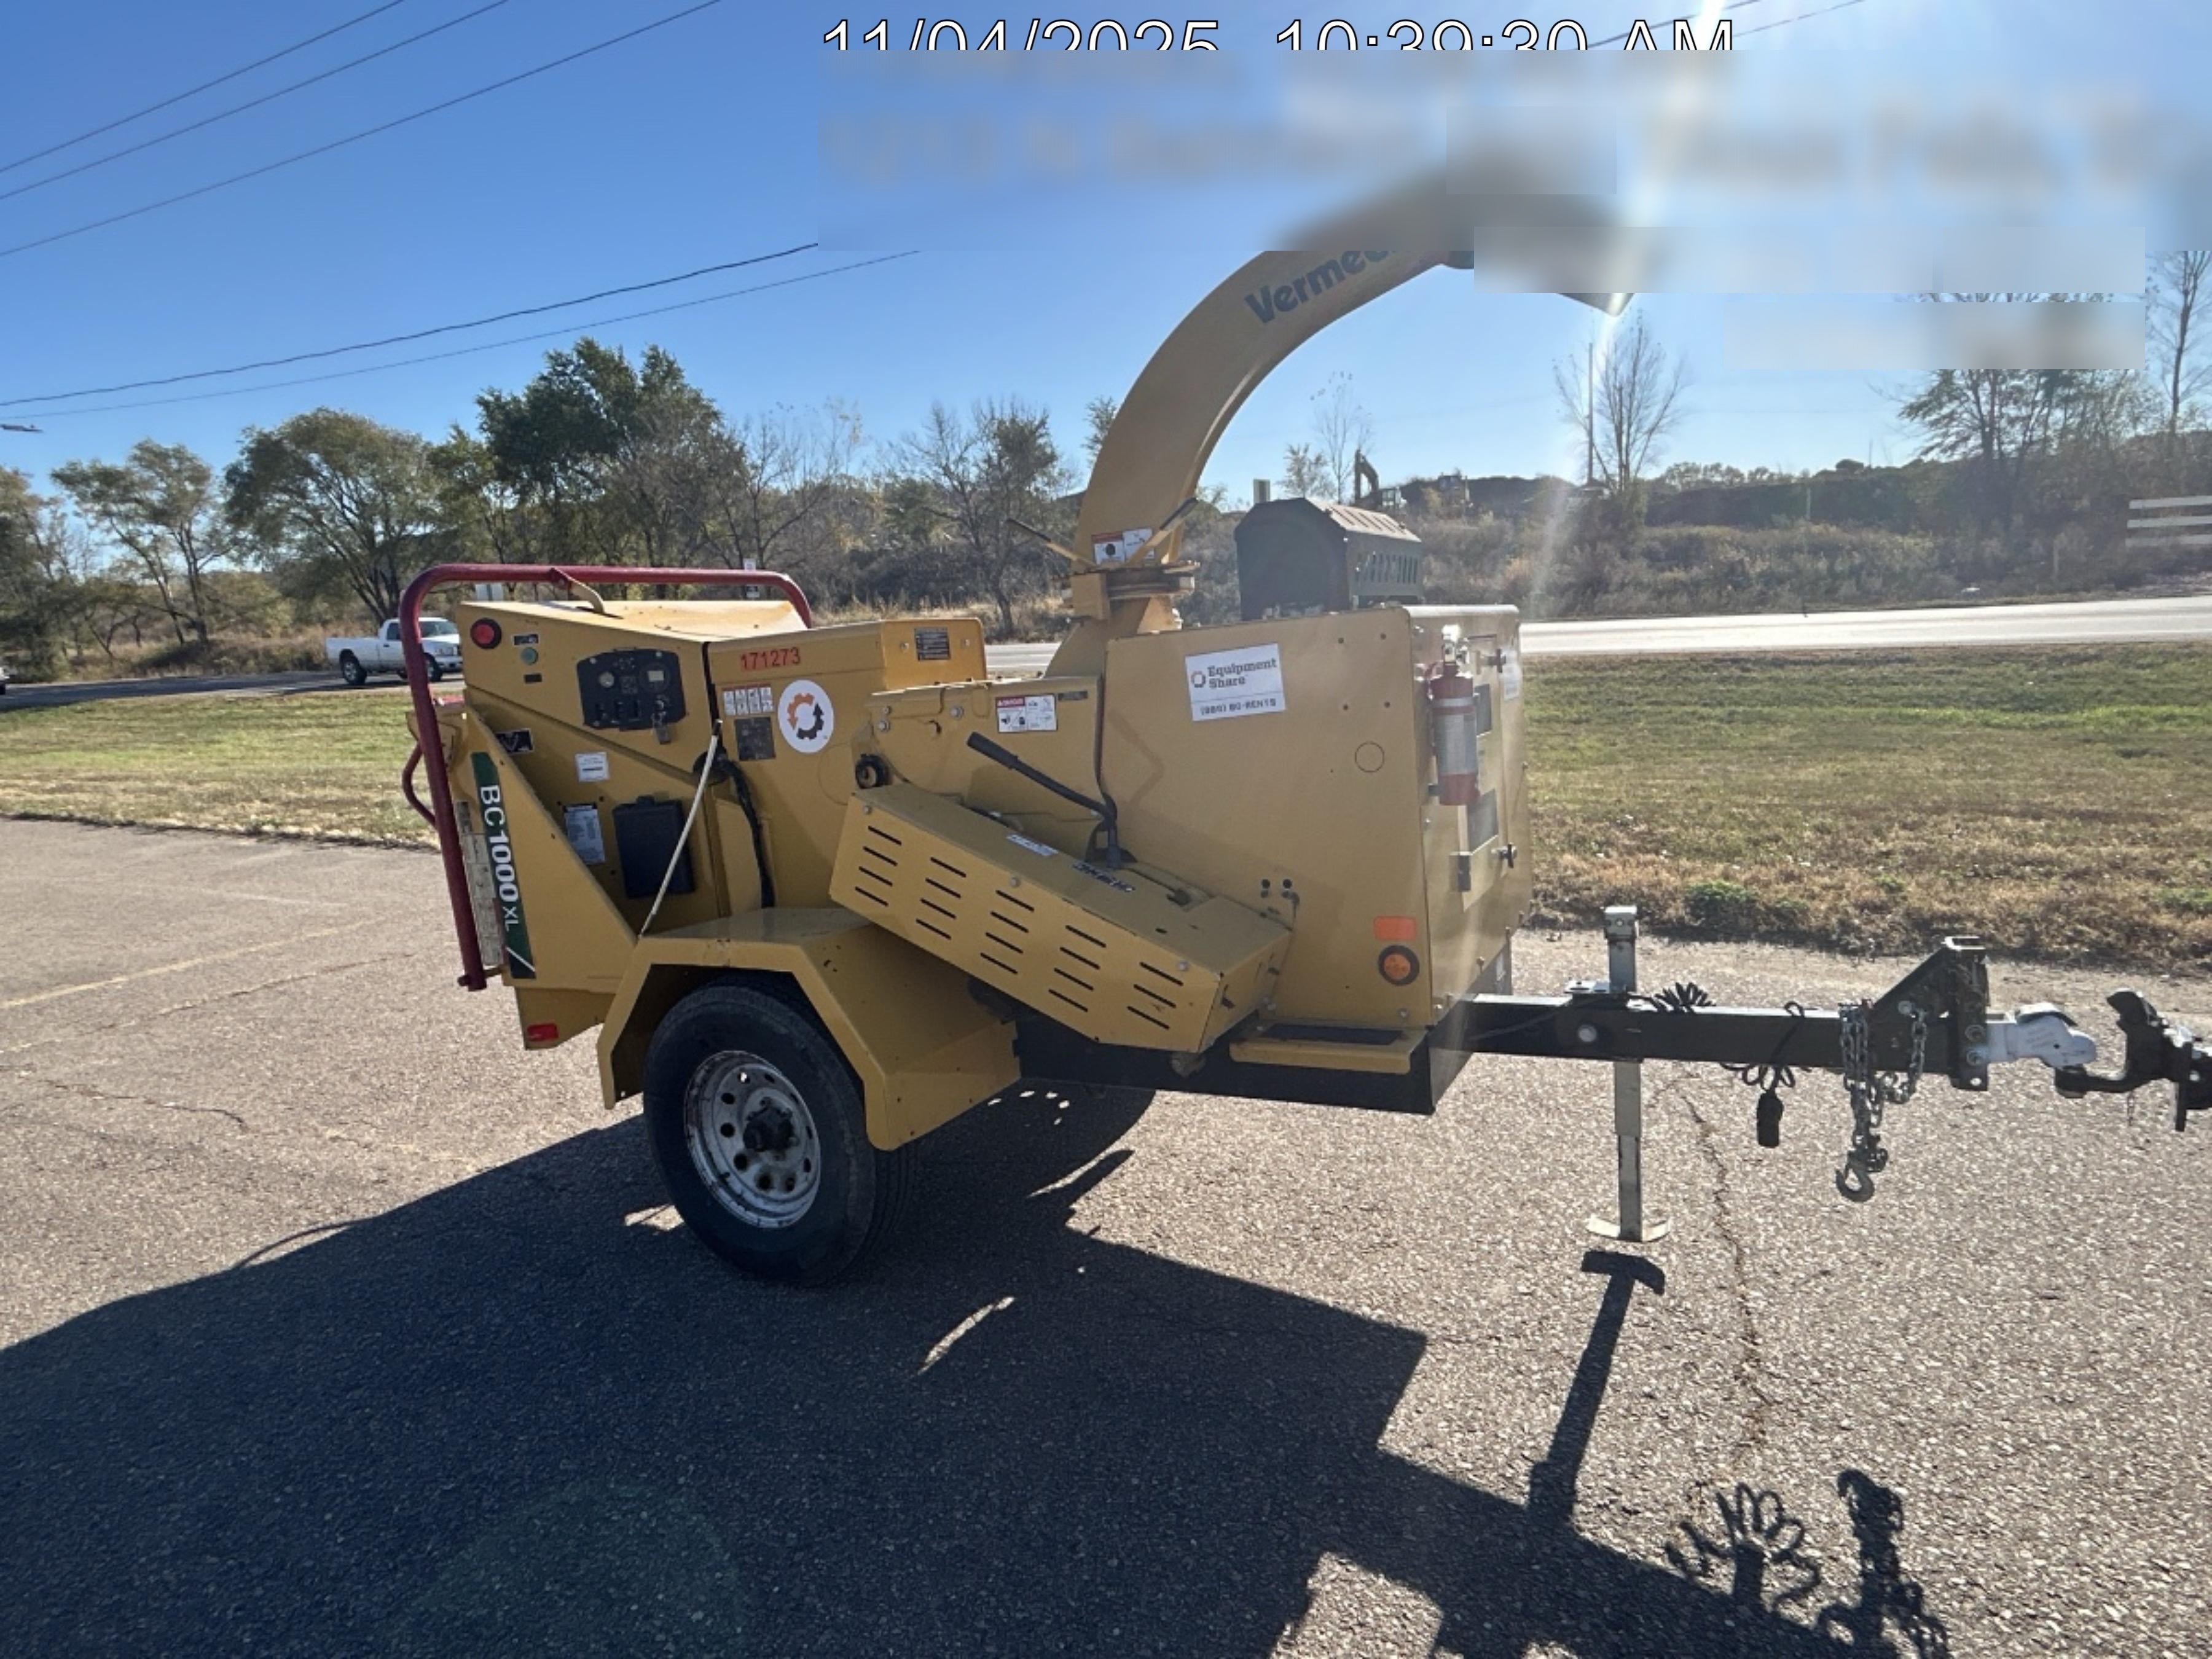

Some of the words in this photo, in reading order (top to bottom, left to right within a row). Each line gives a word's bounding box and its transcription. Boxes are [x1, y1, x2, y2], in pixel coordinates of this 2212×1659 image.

[741, 647, 801, 670] 171273
[1207, 658, 1277, 677] Equipment
[1209, 677, 1245, 688] Share
